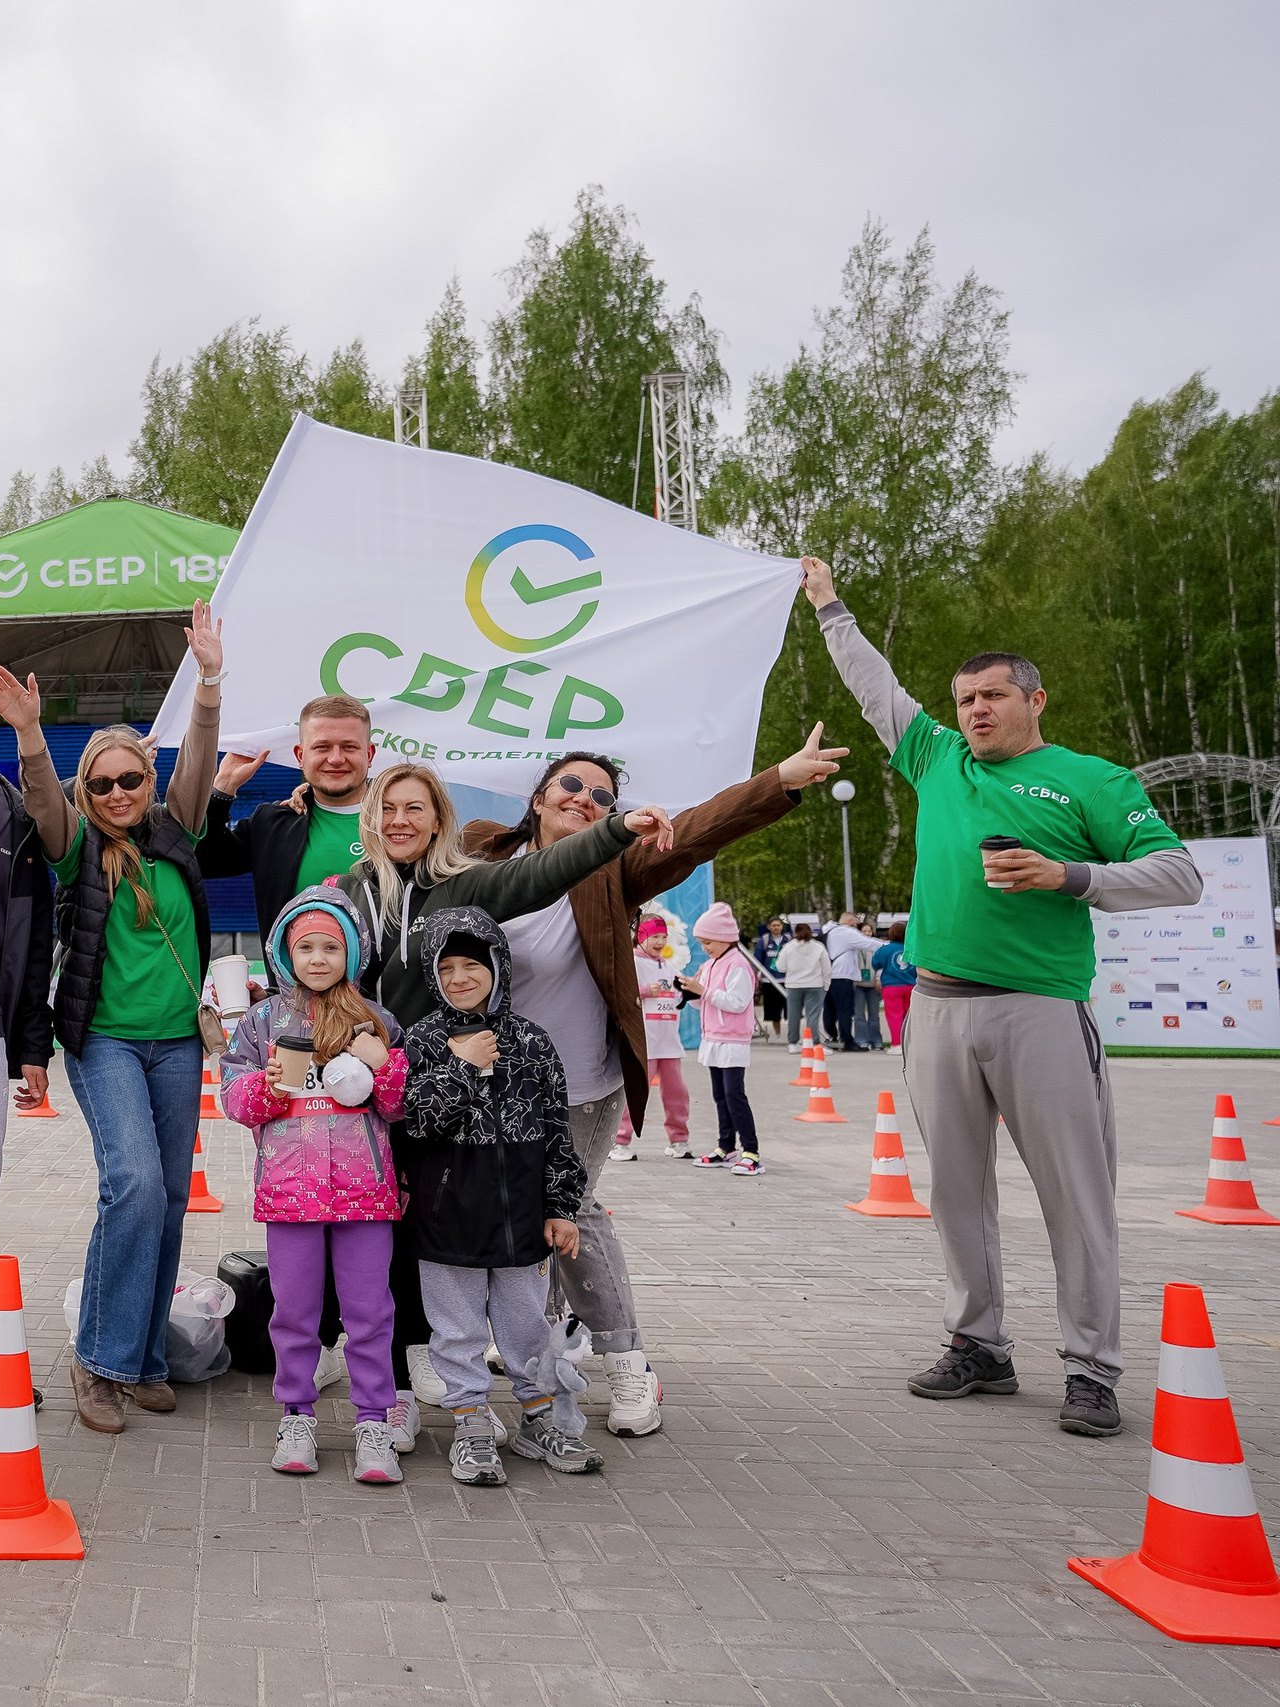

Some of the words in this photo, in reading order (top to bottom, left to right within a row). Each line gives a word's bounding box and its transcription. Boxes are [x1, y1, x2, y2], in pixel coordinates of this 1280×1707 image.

[40, 556, 146, 588] СБЕР
[320, 632, 625, 740] СБЕР
[1028, 786, 1070, 805] СБЕР
[1159, 930, 1182, 938] Utair
